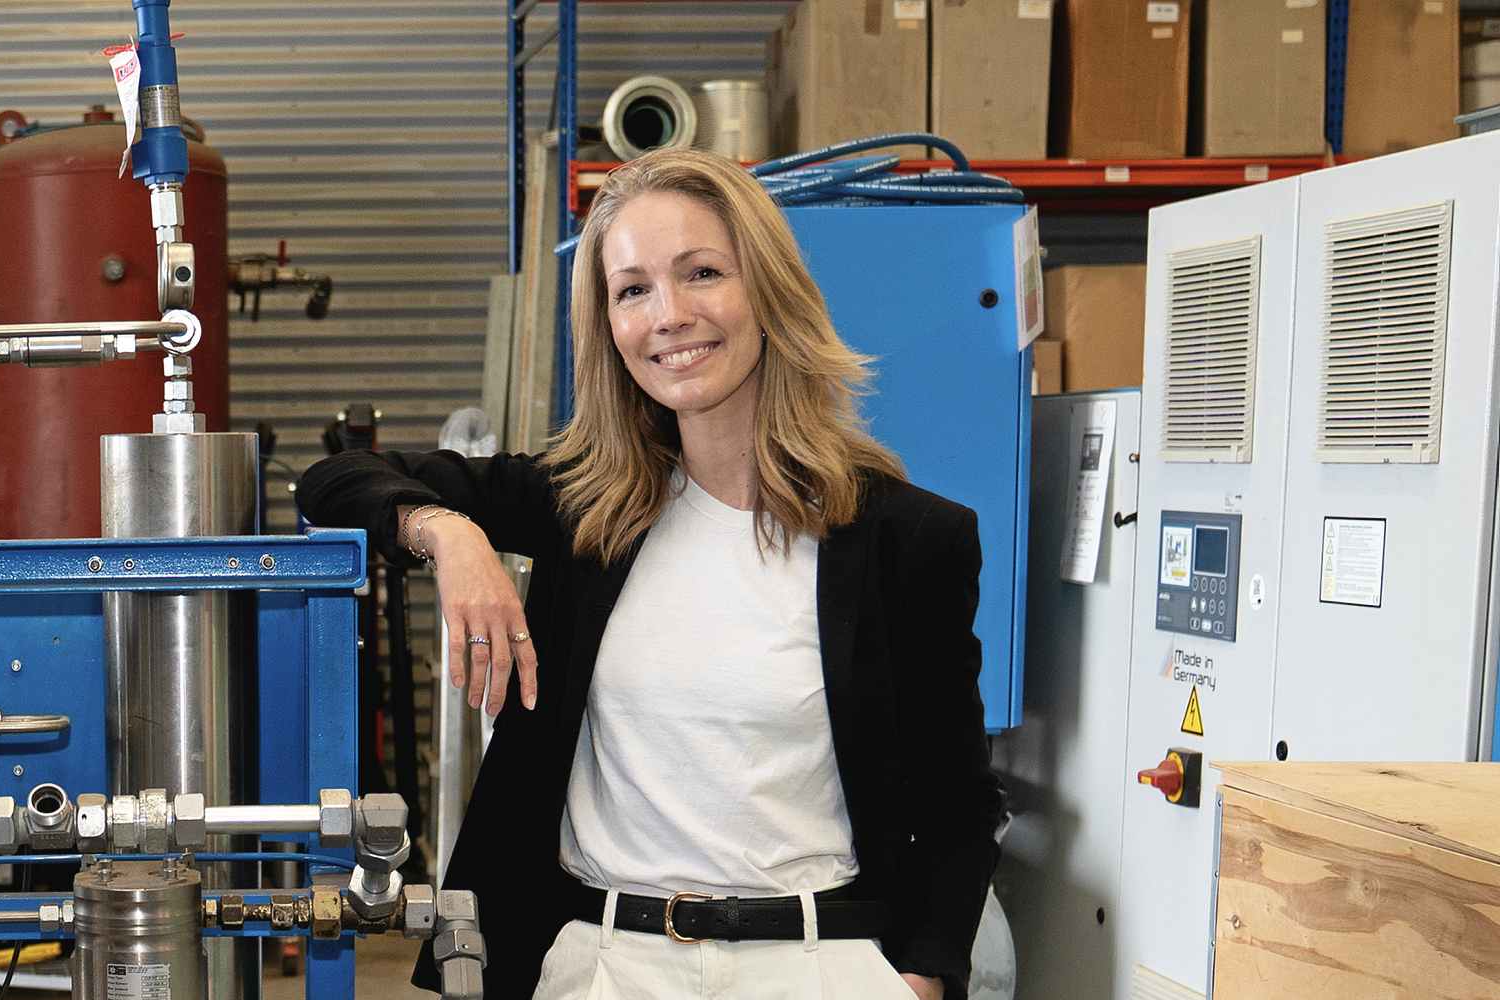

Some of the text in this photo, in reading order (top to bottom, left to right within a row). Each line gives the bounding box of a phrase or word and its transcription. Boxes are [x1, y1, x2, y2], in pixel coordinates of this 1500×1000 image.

[1174, 650, 1213, 669] Made in
[1173, 667, 1216, 692] Germany
